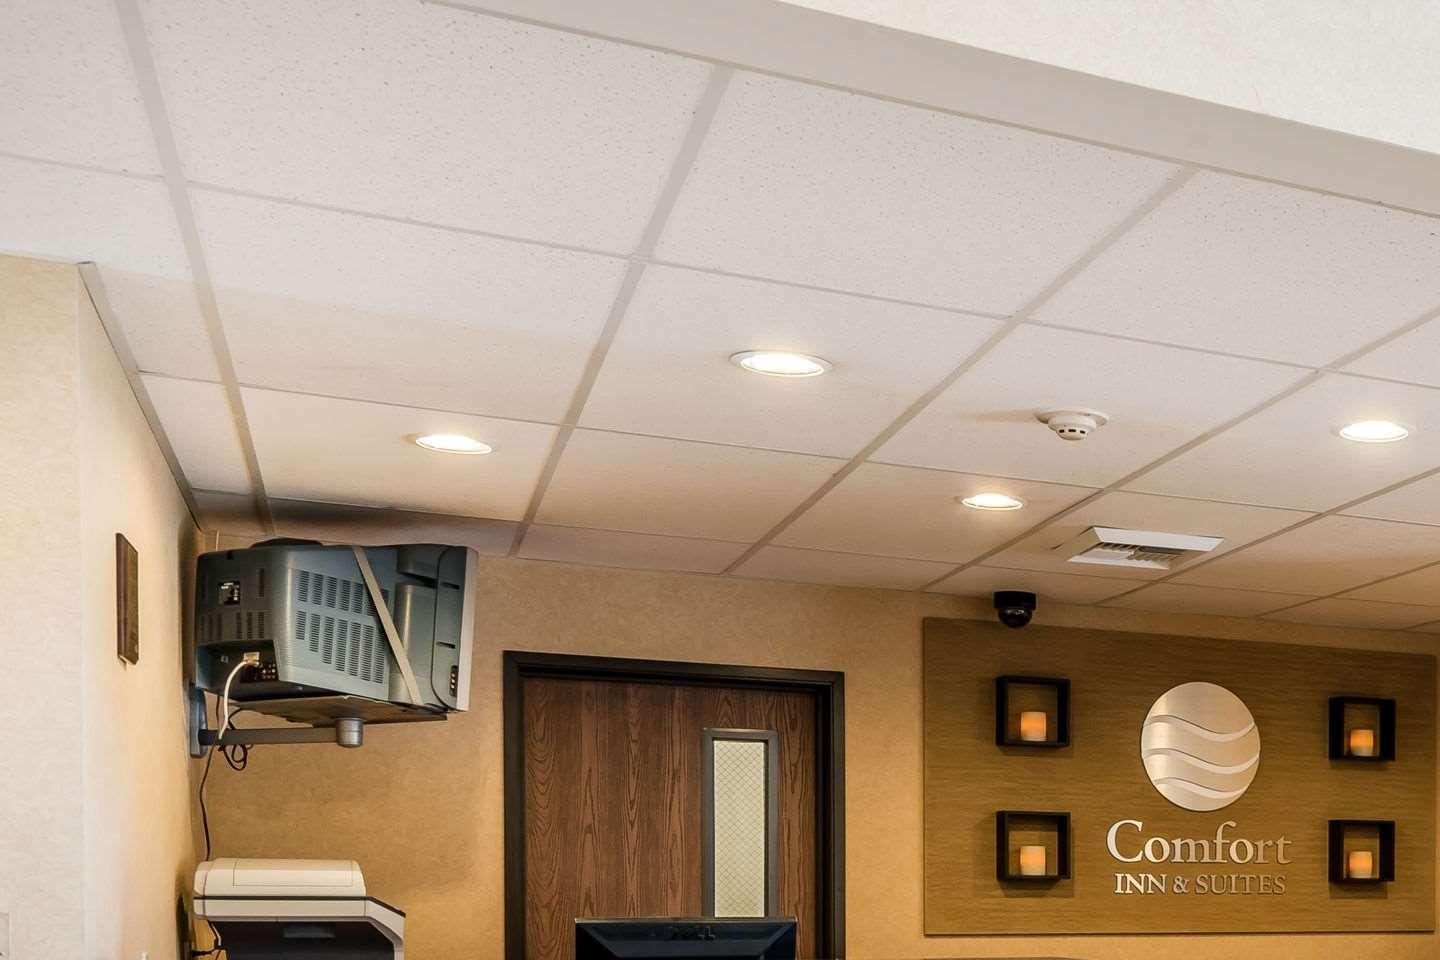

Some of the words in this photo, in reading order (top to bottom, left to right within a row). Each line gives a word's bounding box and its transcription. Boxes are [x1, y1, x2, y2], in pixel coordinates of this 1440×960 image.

[1106, 819, 1293, 864] Comfort
[1115, 873, 1167, 894] INN
[1173, 874, 1190, 894] &
[1195, 874, 1286, 895] SUITES
